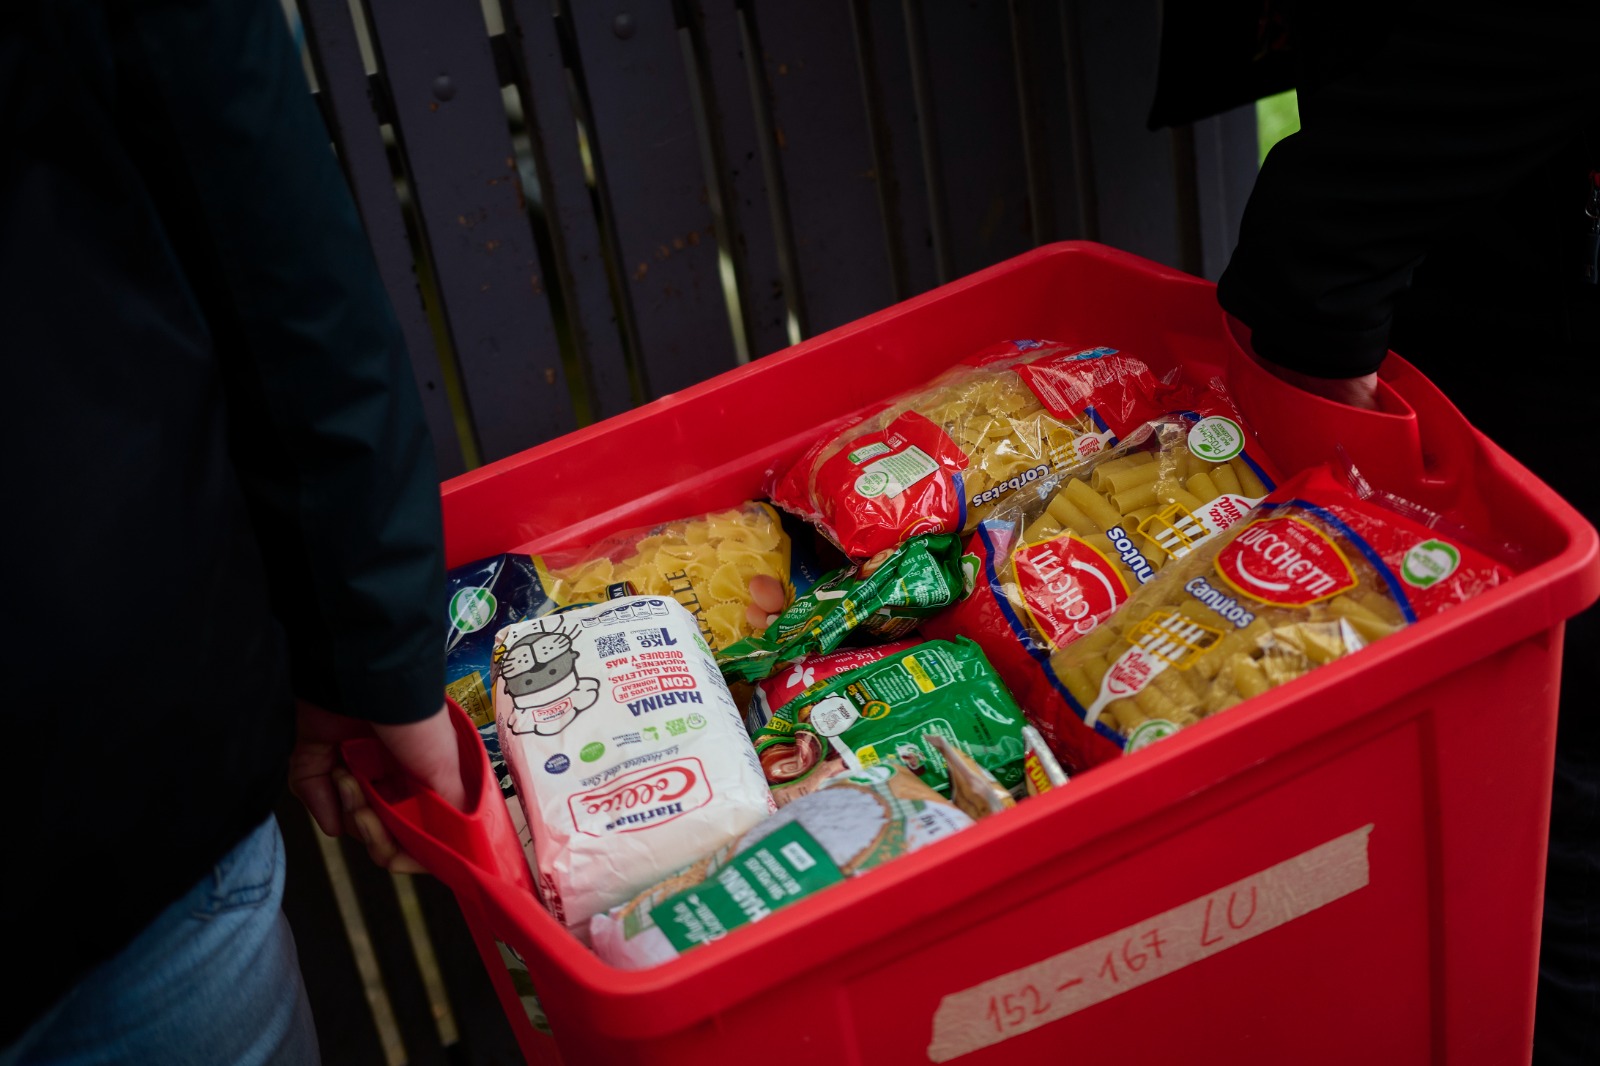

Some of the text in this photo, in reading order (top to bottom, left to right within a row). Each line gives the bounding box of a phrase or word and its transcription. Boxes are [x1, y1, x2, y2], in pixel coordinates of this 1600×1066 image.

[971, 464, 1050, 507] Corbatas
[1106, 525, 1156, 585] nutos
[1235, 525, 1336, 597] LUCCHETTI
[1029, 547, 1099, 634] CCHETTI
[1184, 576, 1255, 630] Canutos
[635, 632, 660, 641] NETO
[639, 627, 677, 649] 1 KG
[605, 649, 683, 668] QUEQUES Y MÁS
[855, 651, 872, 661] kg
[607, 665, 688, 684] PARA GALLETAS,
[621, 678, 656, 691] HORNEAR
[660, 676, 693, 689] CON
[626, 690, 702, 716] HARINA
[630, 684, 658, 696] POLVOS
[580, 766, 695, 814] Collico
[605, 801, 682, 831] Harinas
[716, 864, 770, 923] HARINA
